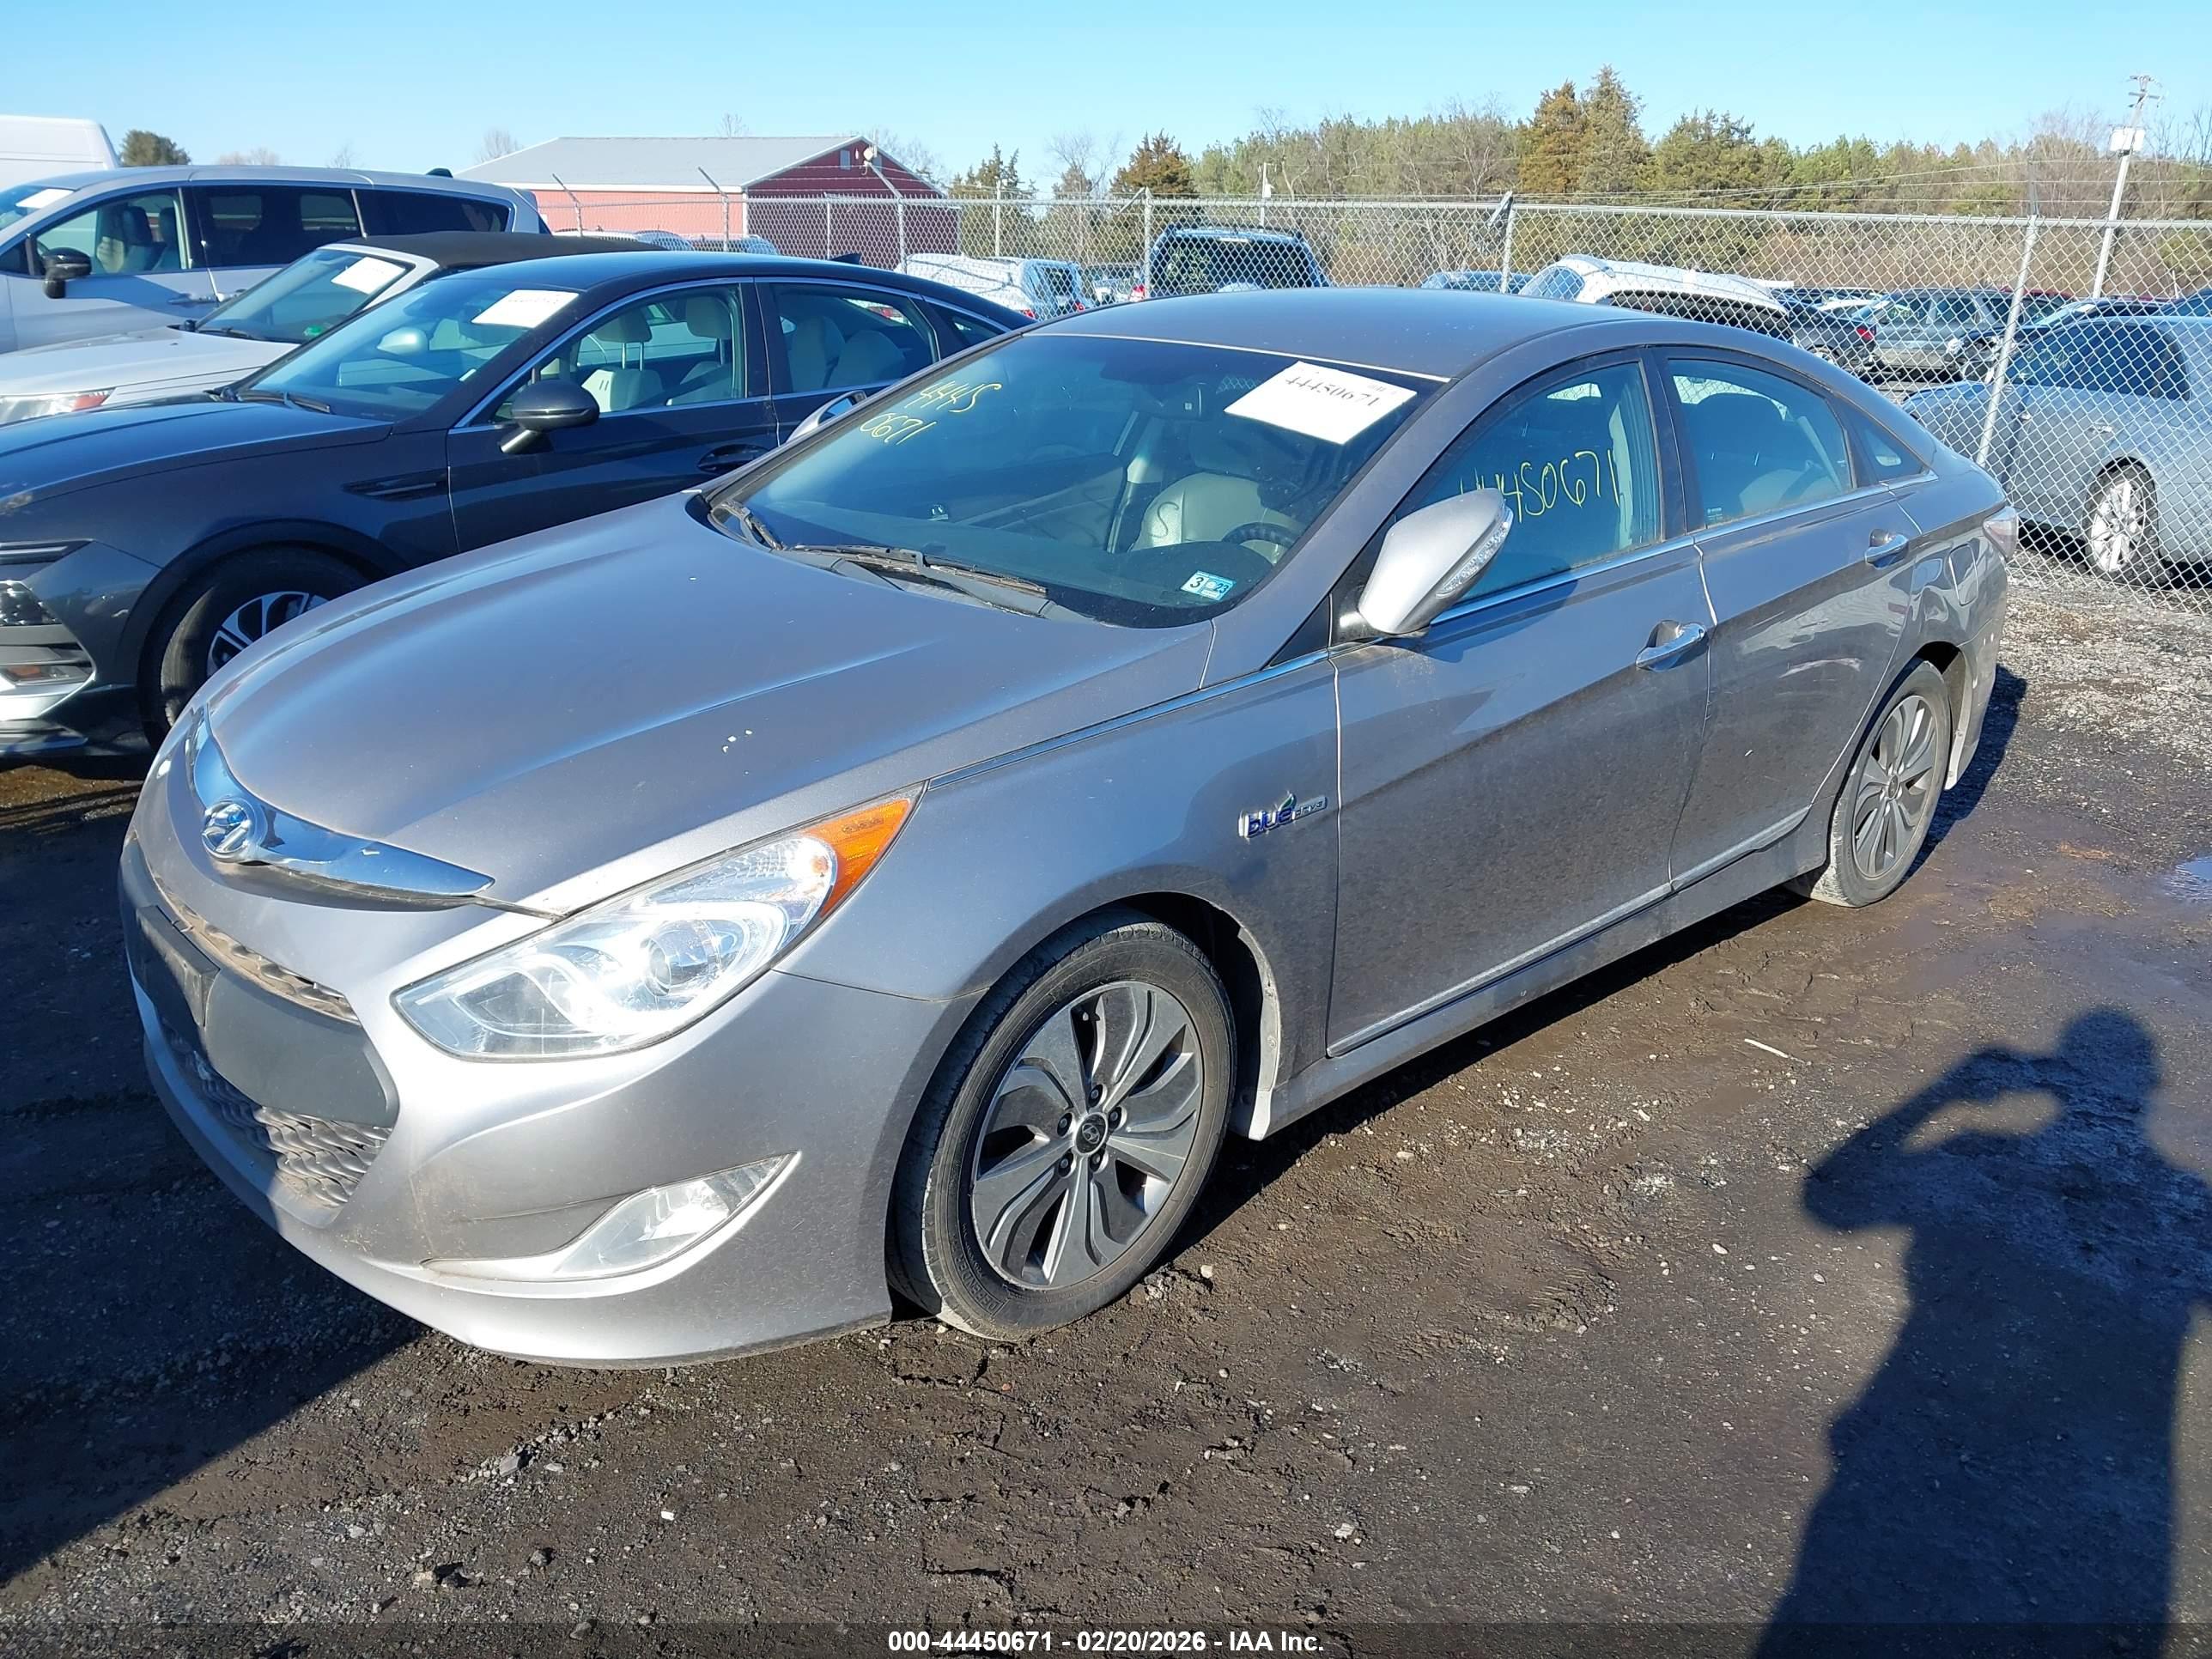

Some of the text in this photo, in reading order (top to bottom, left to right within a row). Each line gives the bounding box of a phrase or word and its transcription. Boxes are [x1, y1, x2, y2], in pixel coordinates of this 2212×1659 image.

[1285, 375, 1381, 406] 44450671
[860, 412, 937, 446] 0671
[1190, 577, 1204, 587] 3
